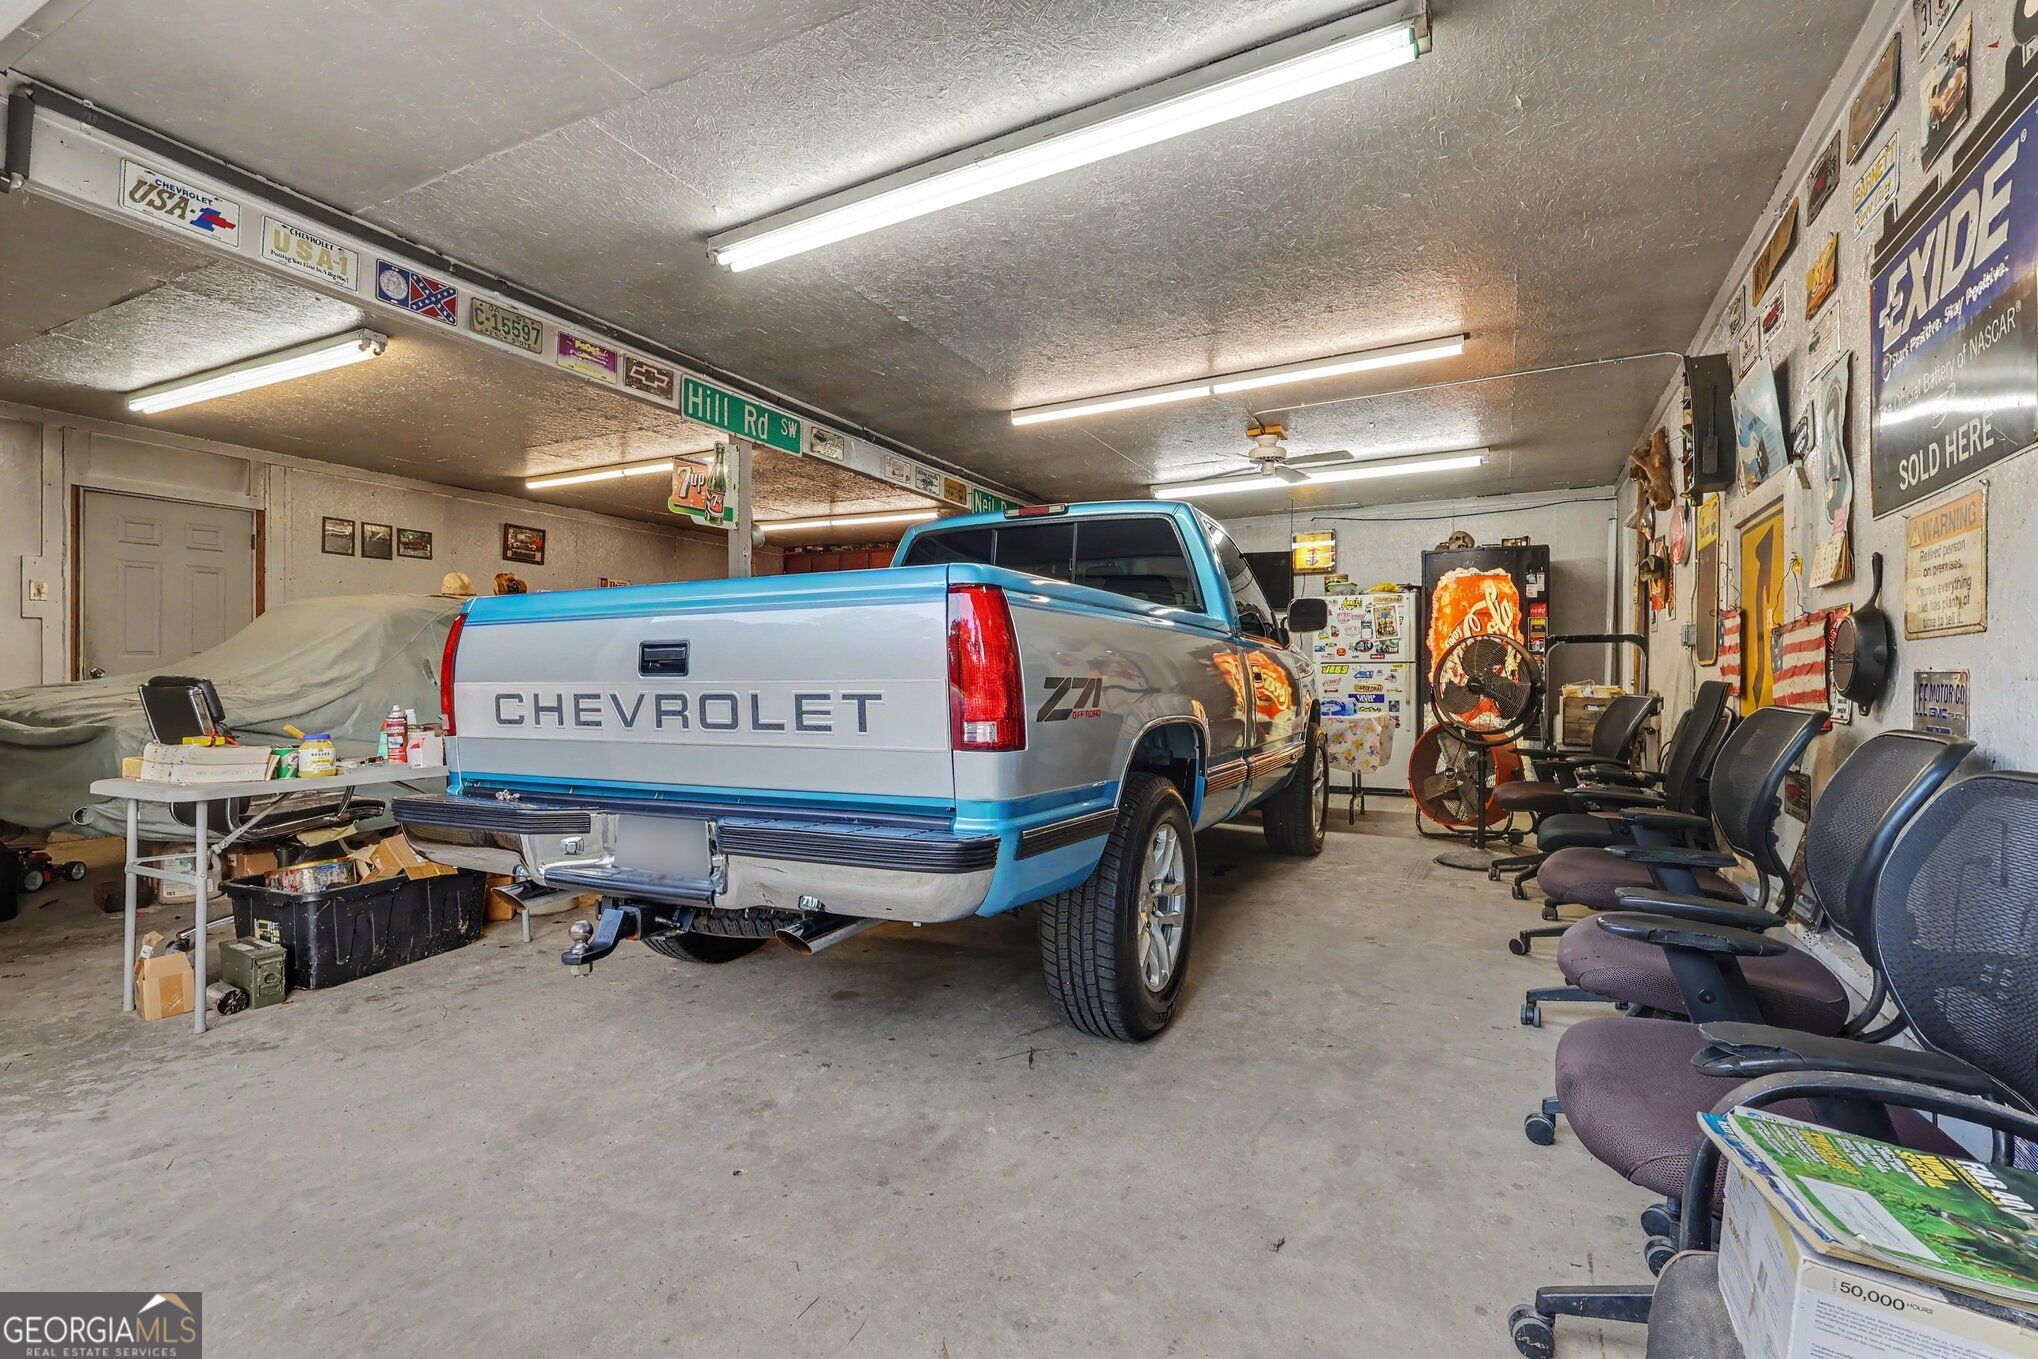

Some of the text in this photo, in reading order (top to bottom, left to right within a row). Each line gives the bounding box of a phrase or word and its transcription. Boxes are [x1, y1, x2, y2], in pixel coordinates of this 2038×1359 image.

[155, 178, 213, 206] CHEVROLET
[289, 227, 335, 251] CHEVROLET
[1943, 296, 1965, 324] Stay
[474, 307, 541, 346] C-15597
[1923, 357, 1955, 394] Battery
[1956, 342, 1967, 369] of
[1968, 305, 2016, 361] NASCAR
[687, 382, 729, 427] Hill
[744, 404, 769, 441] Rd
[780, 418, 798, 439] SW
[1899, 409, 1995, 491] SOLD HERE
[974, 490, 1000, 512] Neil
[1921, 500, 1977, 542] WARNING
[1919, 539, 1966, 563] Retired person
[1923, 567, 1932, 578] on
[1937, 575, 1972, 597] everything
[1929, 600, 1941, 612] has
[1962, 593, 1970, 607] of
[1938, 615, 1944, 627] to
[1945, 612, 1956, 626] tell
[1929, 683, 1954, 704] MOTOR
[494, 690, 884, 734] CHEVROLET
[1839, 1281, 1934, 1316] 50,000 HOURS
